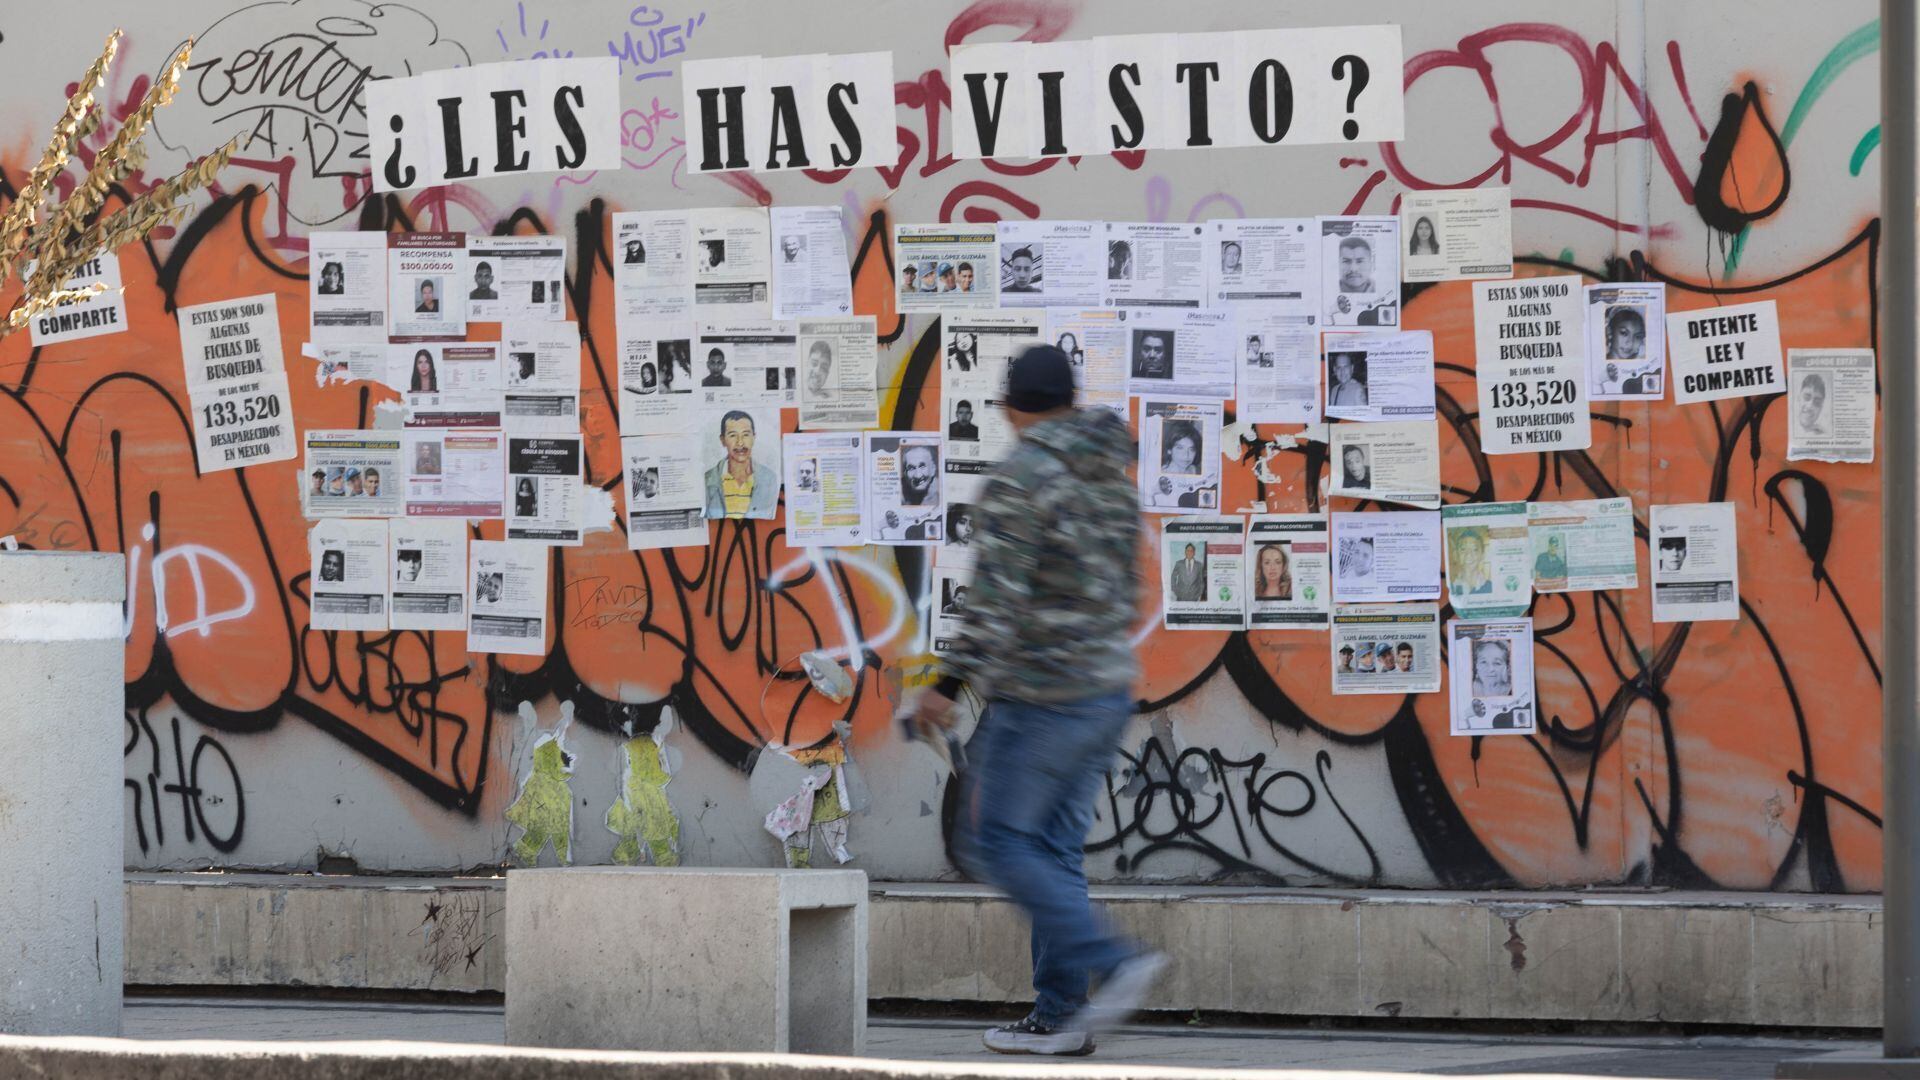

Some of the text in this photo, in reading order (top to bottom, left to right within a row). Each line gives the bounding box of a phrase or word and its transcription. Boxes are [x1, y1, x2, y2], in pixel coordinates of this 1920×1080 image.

[384, 85, 588, 189] ¿LES
[696, 81, 863, 171] HAS
[963, 54, 1371, 157] VISTO?
[400, 263, 454, 271] $300,000.00
[1488, 284, 1568, 302] ESTAS SON SOLO
[192, 303, 264, 325] ESTAS SON SOLO
[1507, 303, 1552, 318] ALGUNAS
[39, 306, 118, 336] COMPARTE
[210, 322, 250, 339] ALGUNAS
[1500, 320, 1562, 339] FICHAS DE
[1688, 313, 1758, 339] DETENTE
[204, 338, 260, 360] FICHAS DE
[1500, 342, 1563, 361] BUSQUEDA
[1706, 342, 1745, 364] LEE Y
[206, 358, 262, 380] BUSQUEDA
[1510, 368, 1518, 376] DE
[1520, 368, 1532, 376] LOS
[1546, 366, 1555, 374] DE
[218, 388, 226, 396] DE
[228, 387, 238, 396] LOS
[251, 383, 260, 391] DE
[1684, 365, 1775, 394] COMPARTE
[1491, 379, 1576, 410] 133,520
[203, 394, 280, 428] 133,520
[1496, 412, 1575, 428] DESAPARECIDOS
[210, 426, 280, 447] DESAPARECIDOS
[1511, 428, 1562, 444] EN MÉXICO
[224, 444, 270, 462] EN MÉXICO
